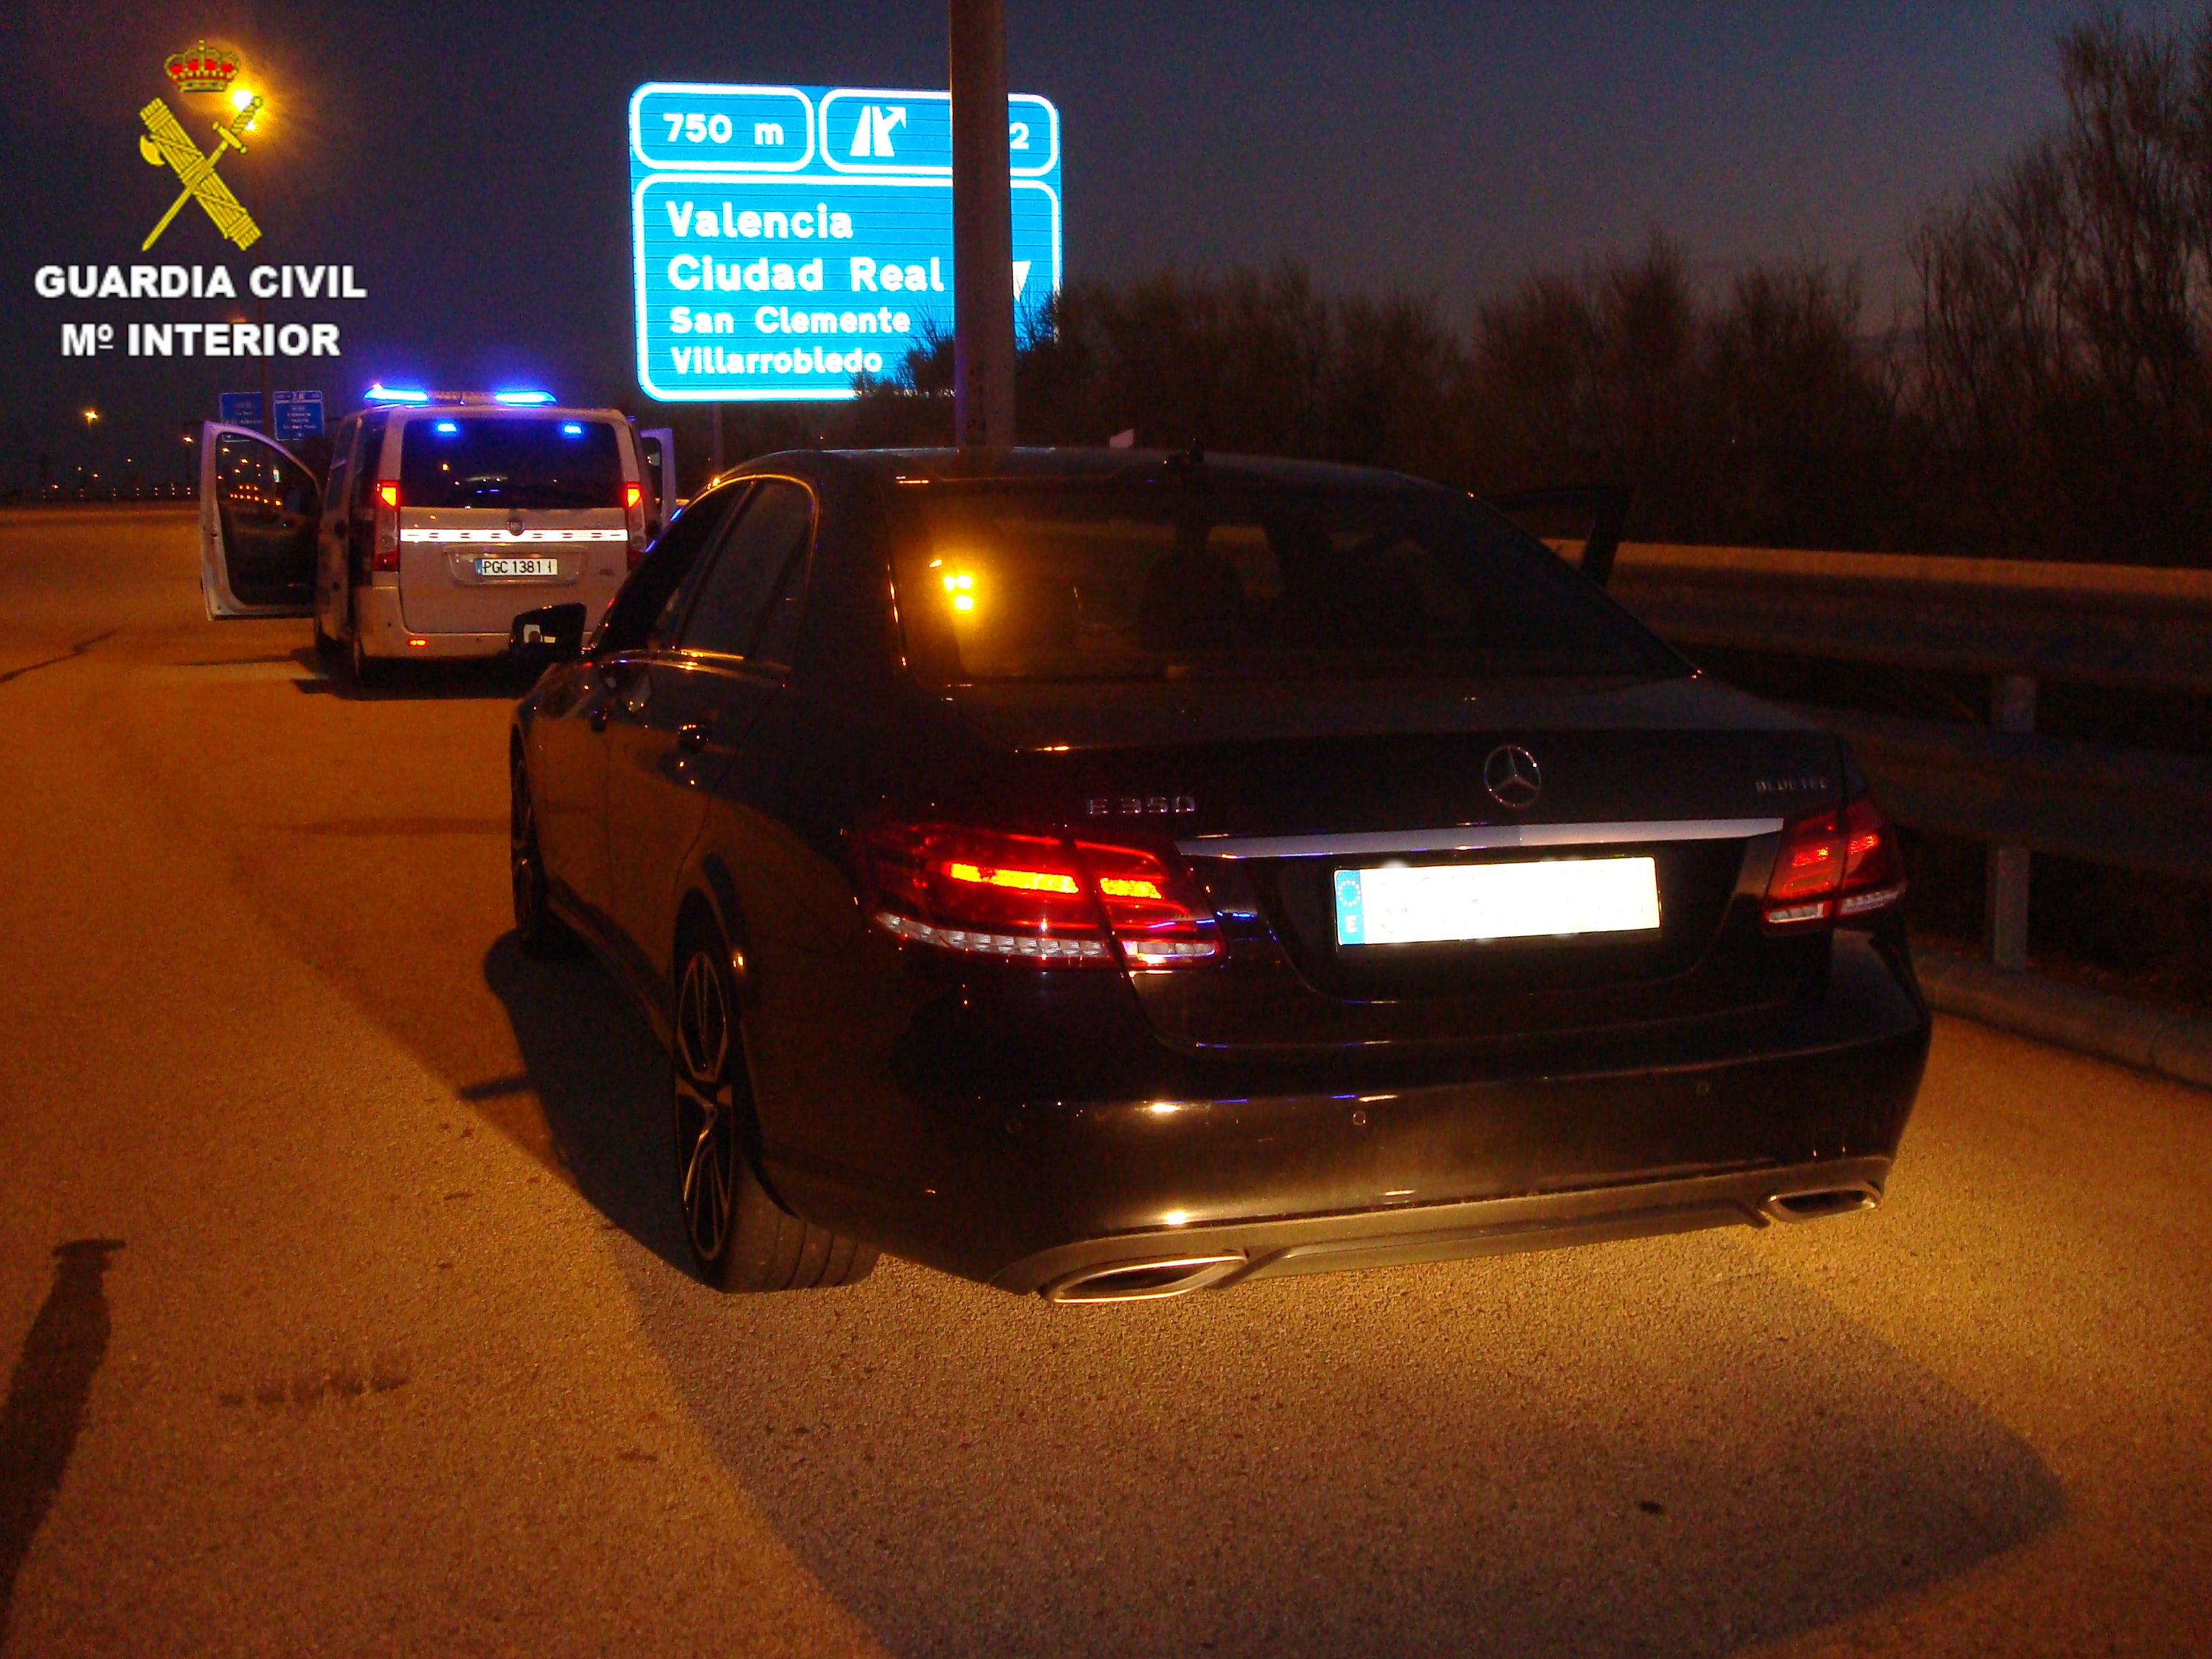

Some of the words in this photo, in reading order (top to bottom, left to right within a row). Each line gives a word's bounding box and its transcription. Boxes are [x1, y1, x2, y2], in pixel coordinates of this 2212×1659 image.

[662, 113, 732, 143] 750
[754, 122, 784, 145] m
[665, 201, 854, 239] Valencia
[667, 253, 824, 292] Ciudad
[850, 256, 945, 292] Real
[670, 306, 734, 334] San
[755, 305, 911, 334] Clemente
[670, 346, 884, 374] Villarrobledo
[483, 560, 508, 574] PGC
[512, 560, 541, 574] 1381
[1345, 914, 1357, 933] E
